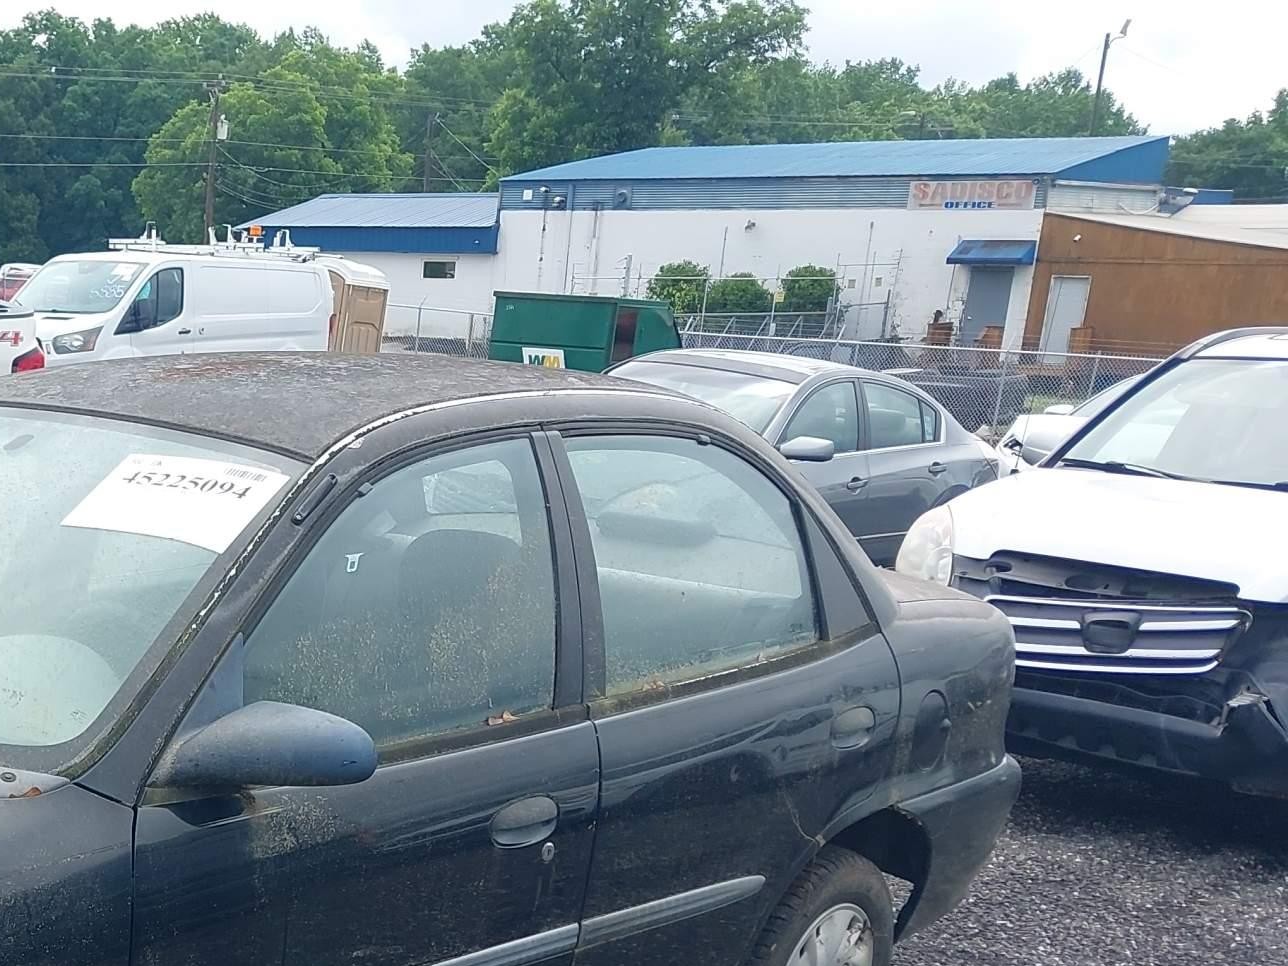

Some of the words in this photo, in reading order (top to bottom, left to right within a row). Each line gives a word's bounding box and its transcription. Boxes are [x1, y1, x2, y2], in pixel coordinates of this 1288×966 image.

[914, 182, 1033, 200] SADISCO
[944, 201, 997, 209] OFFICE
[122, 470, 253, 500] 45225094
